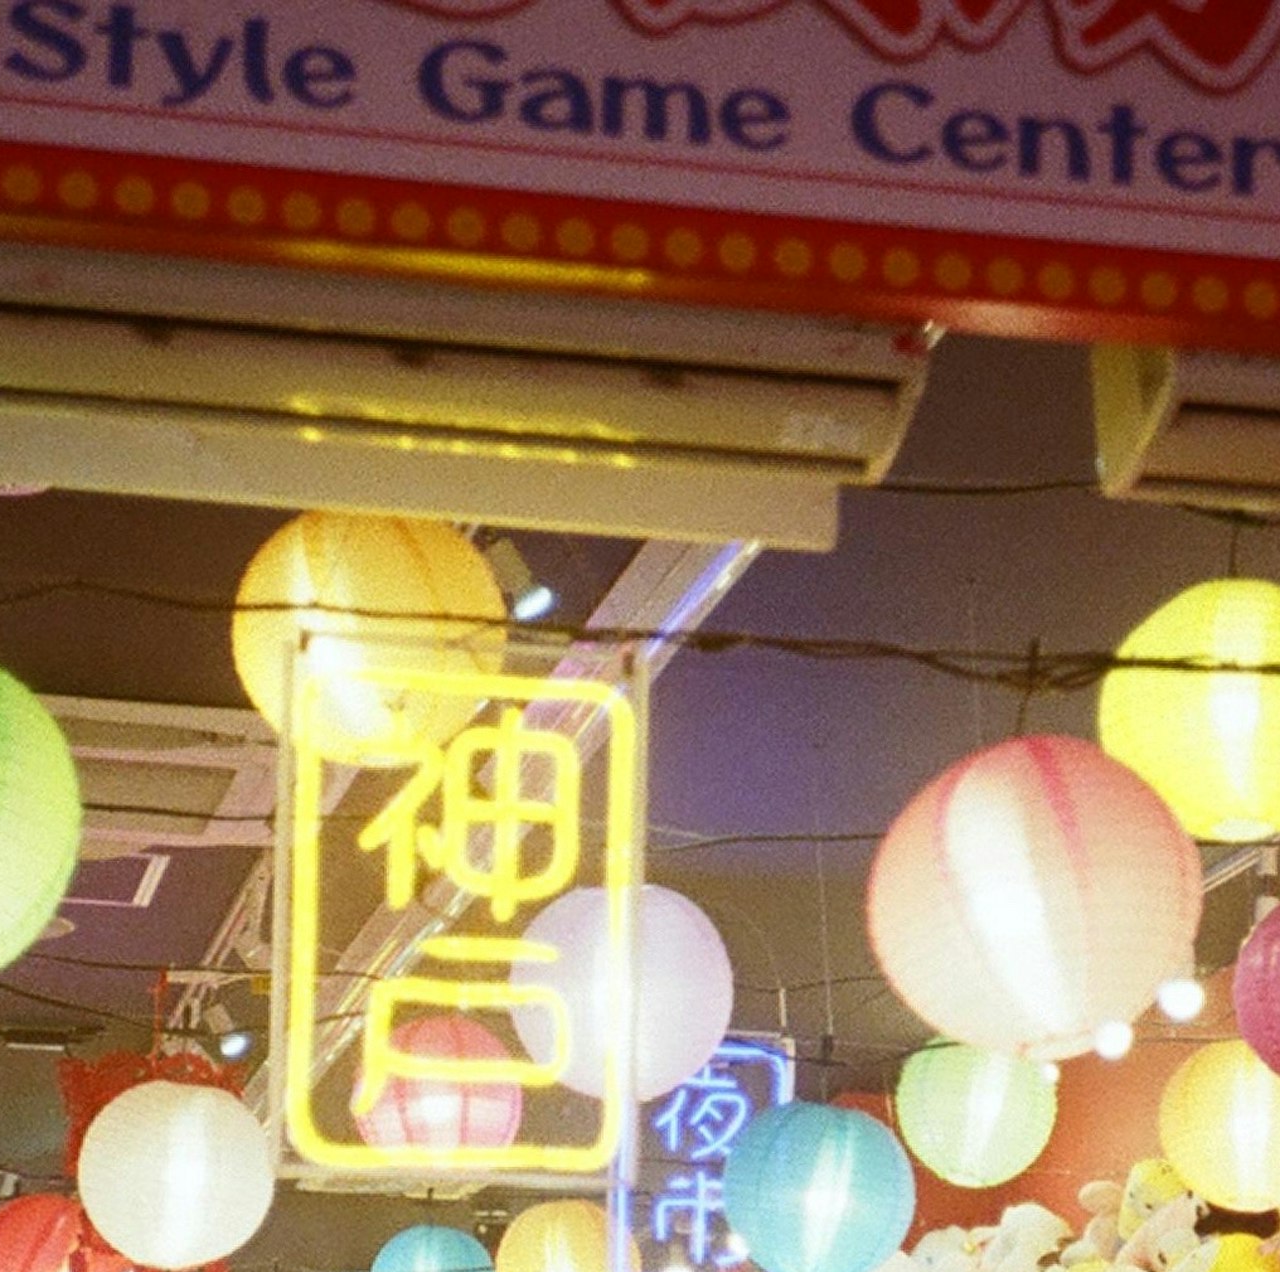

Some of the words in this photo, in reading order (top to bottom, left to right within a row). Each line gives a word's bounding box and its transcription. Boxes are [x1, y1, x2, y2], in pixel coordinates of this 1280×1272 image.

[4, 0, 356, 108] Style
[416, 38, 791, 151] Game
[356, 706, 582, 1116] 神戸
